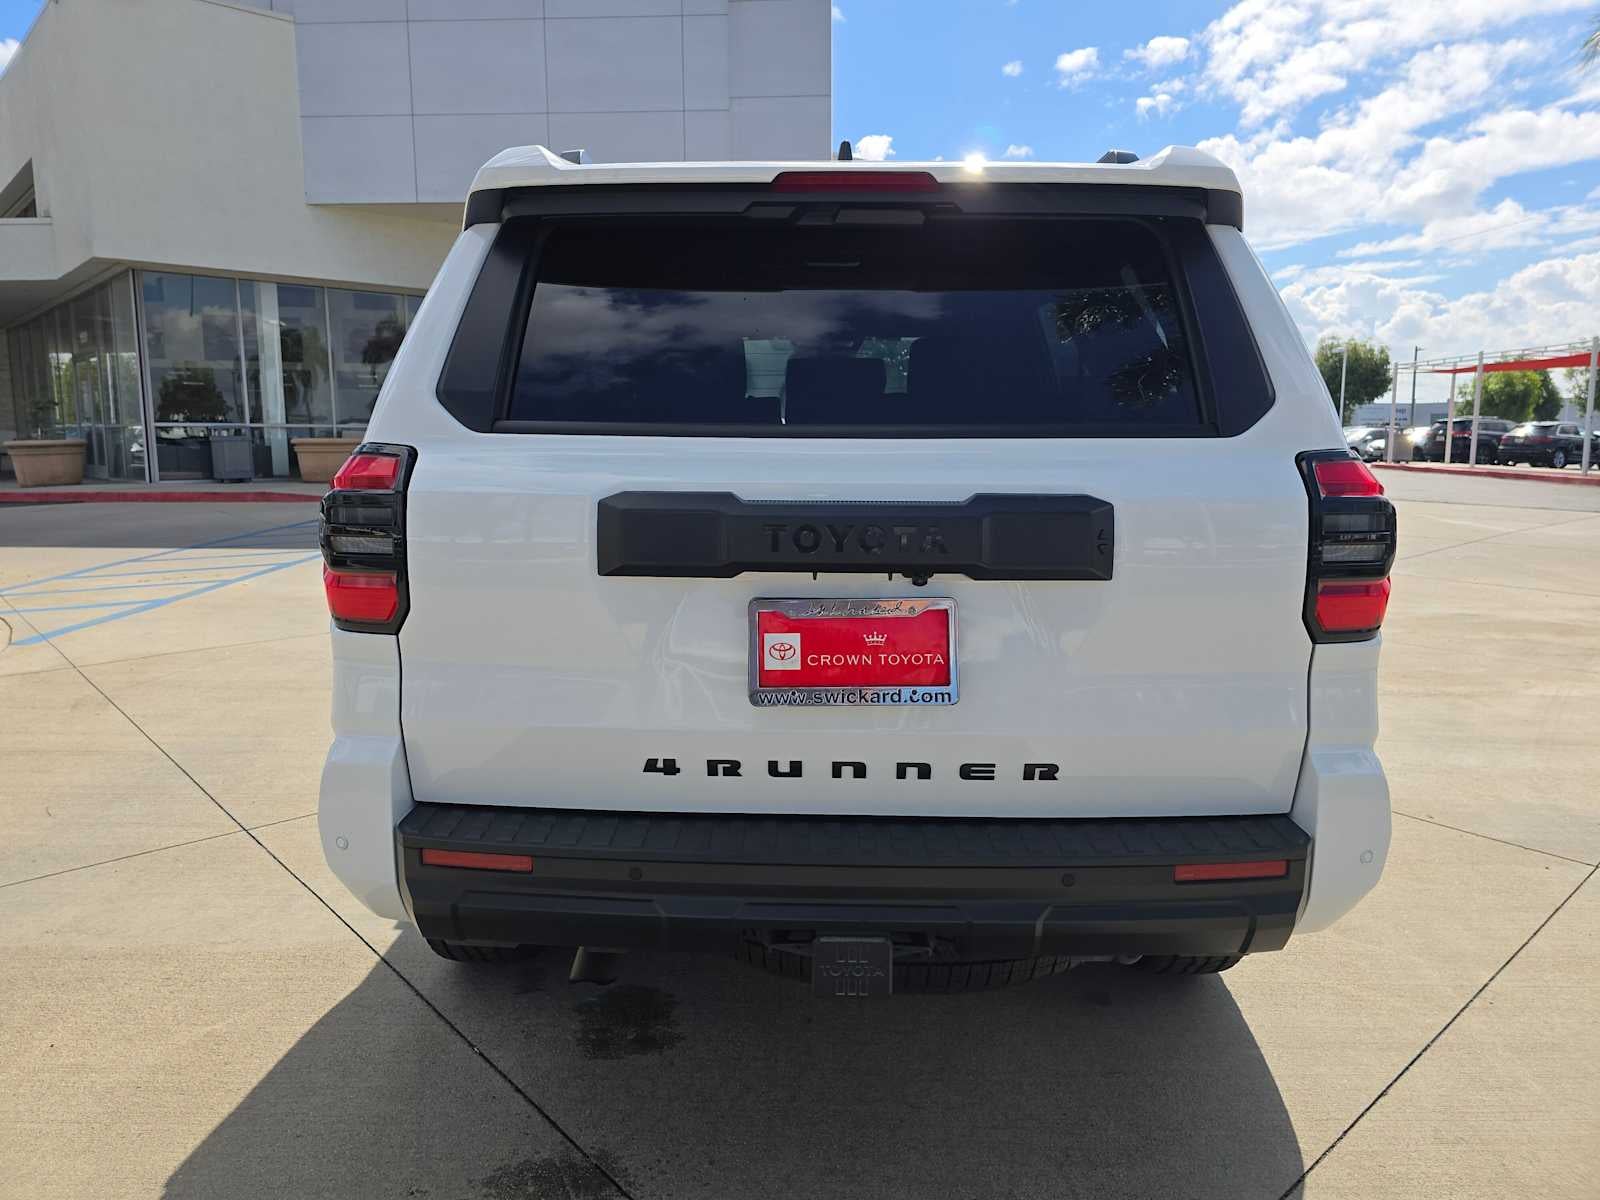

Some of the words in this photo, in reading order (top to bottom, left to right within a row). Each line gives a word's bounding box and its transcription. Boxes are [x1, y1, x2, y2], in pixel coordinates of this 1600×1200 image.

[762, 523, 950, 554] TOYOTA
[807, 654, 872, 666] CROWN
[878, 653, 945, 665] TOYOTA
[758, 689, 952, 705] www.swickard.com
[643, 757, 1060, 781] 4RUNNER
